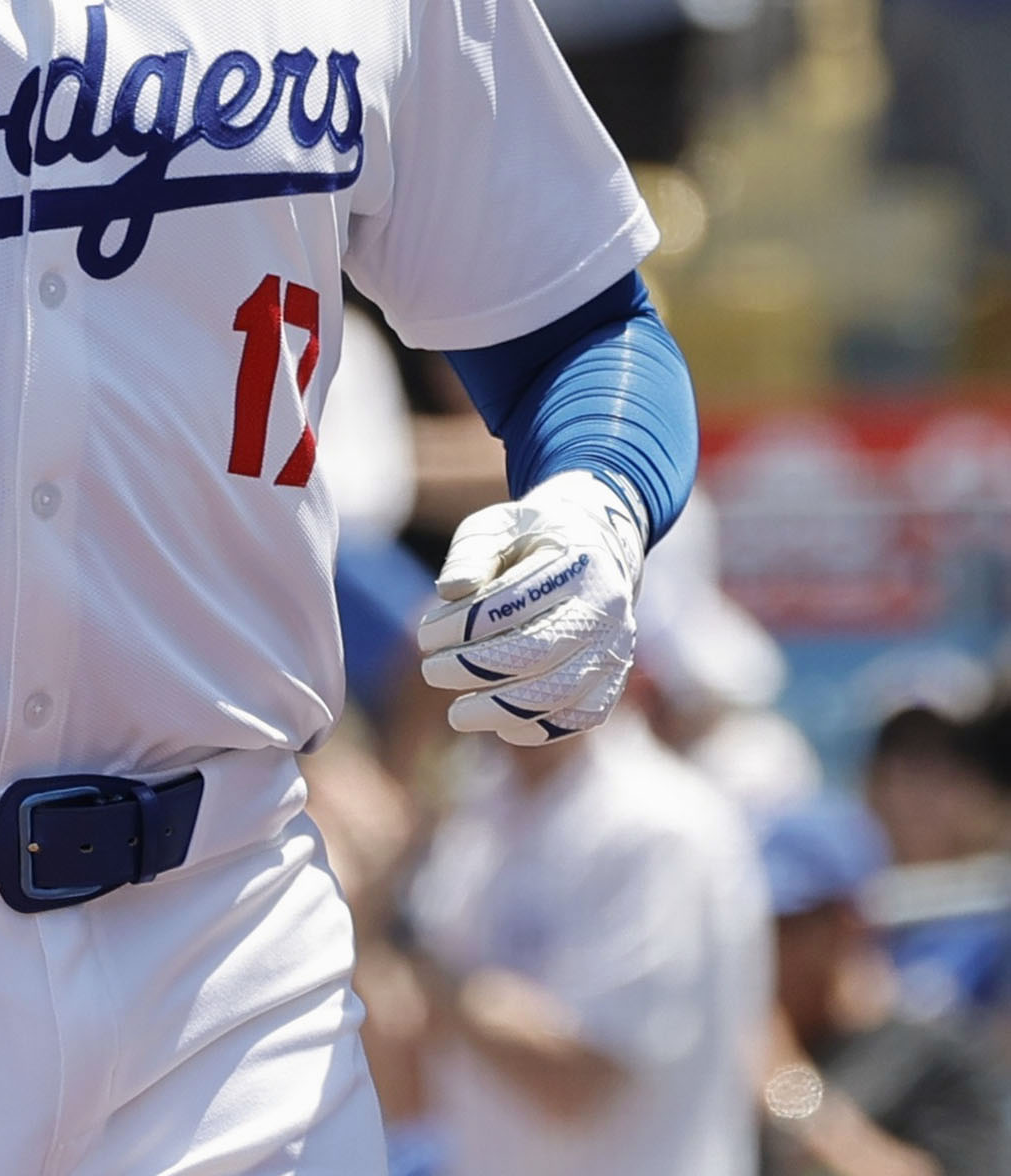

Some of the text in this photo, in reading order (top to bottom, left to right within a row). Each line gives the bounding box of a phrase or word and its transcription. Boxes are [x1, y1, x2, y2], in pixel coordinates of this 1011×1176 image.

[227, 273, 321, 489] 17
[488, 553, 589, 622] new balance
